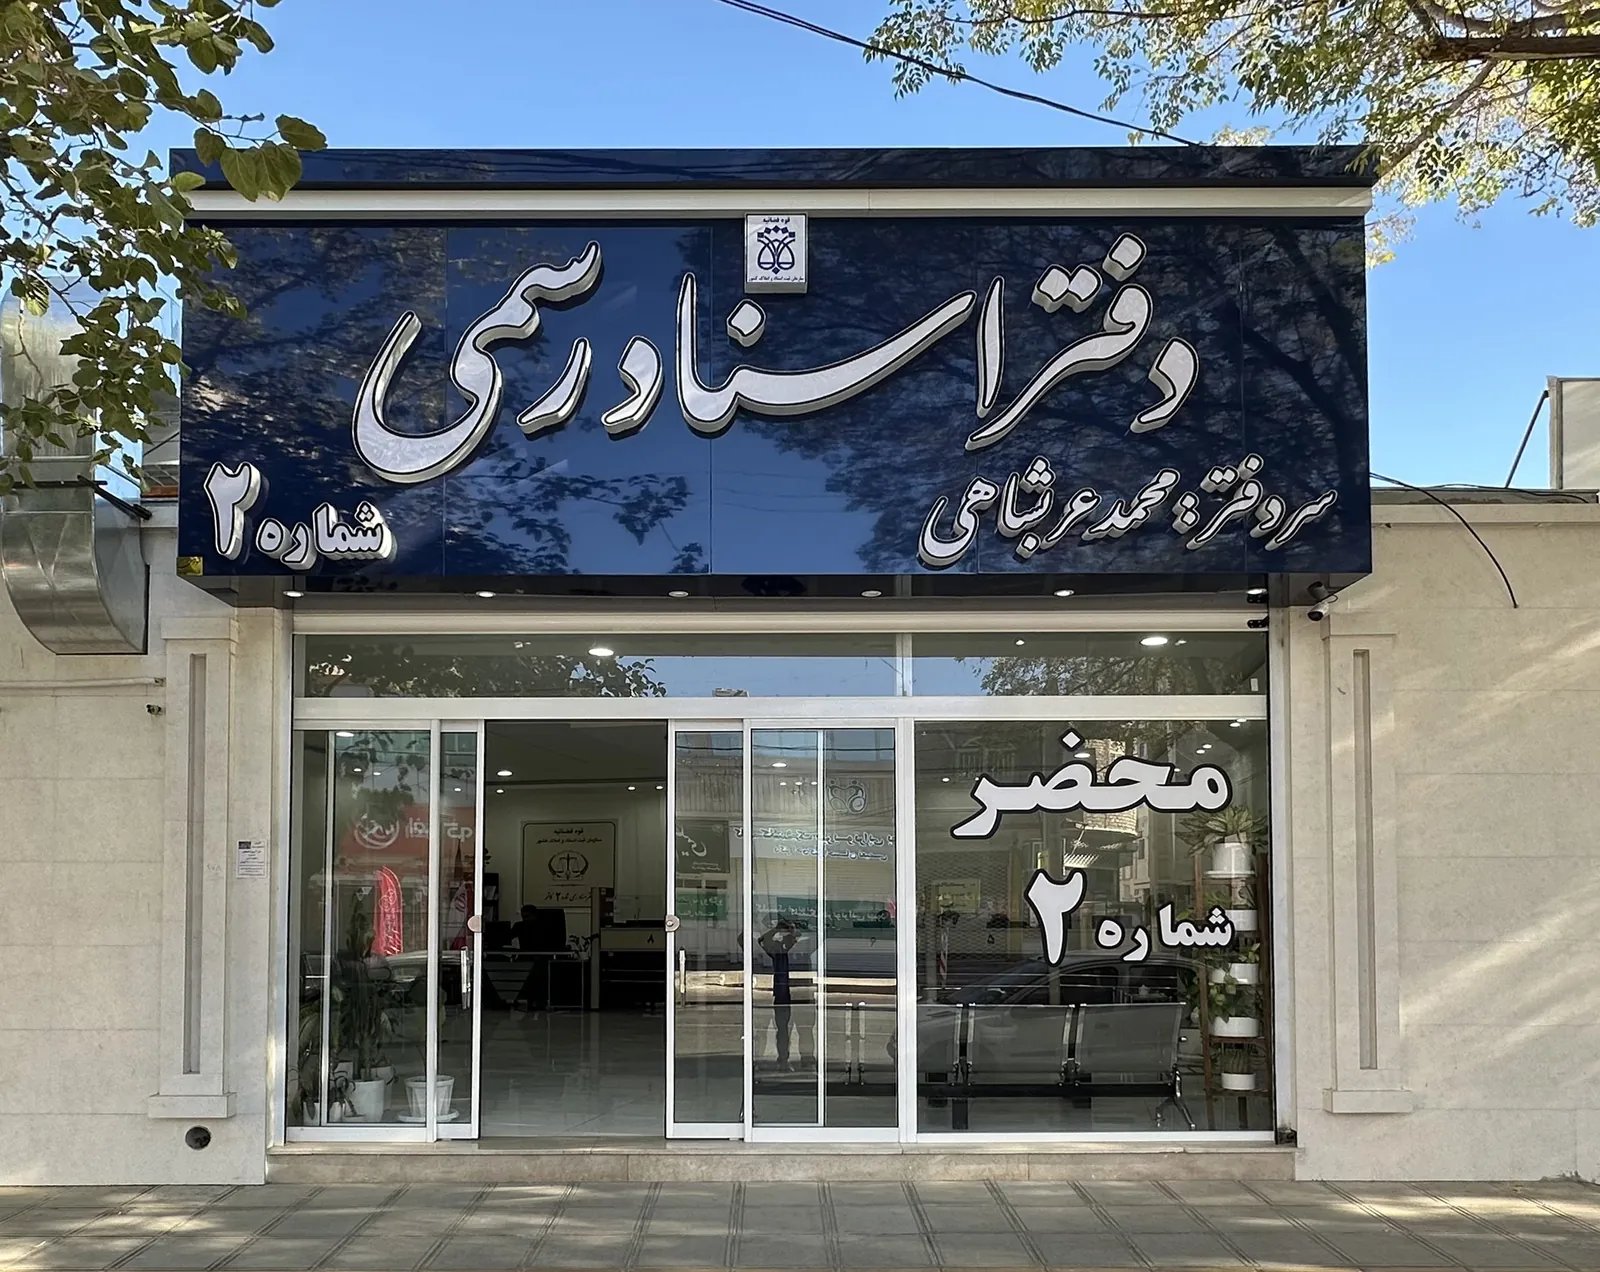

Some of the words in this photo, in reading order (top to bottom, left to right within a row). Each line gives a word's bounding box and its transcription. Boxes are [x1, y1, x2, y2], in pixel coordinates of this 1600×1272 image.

[352, 240, 602, 483] رسمی
[602, 272, 1005, 434] اسناد
[965, 233, 1199, 450] دفتر
[204, 461, 261, 560] ۲
[256, 502, 394, 570] شماره
[1082, 468, 1180, 541] محمد
[950, 729, 1233, 838] محضر
[1025, 869, 1087, 965] ۲
[1096, 903, 1235, 962] شماره
